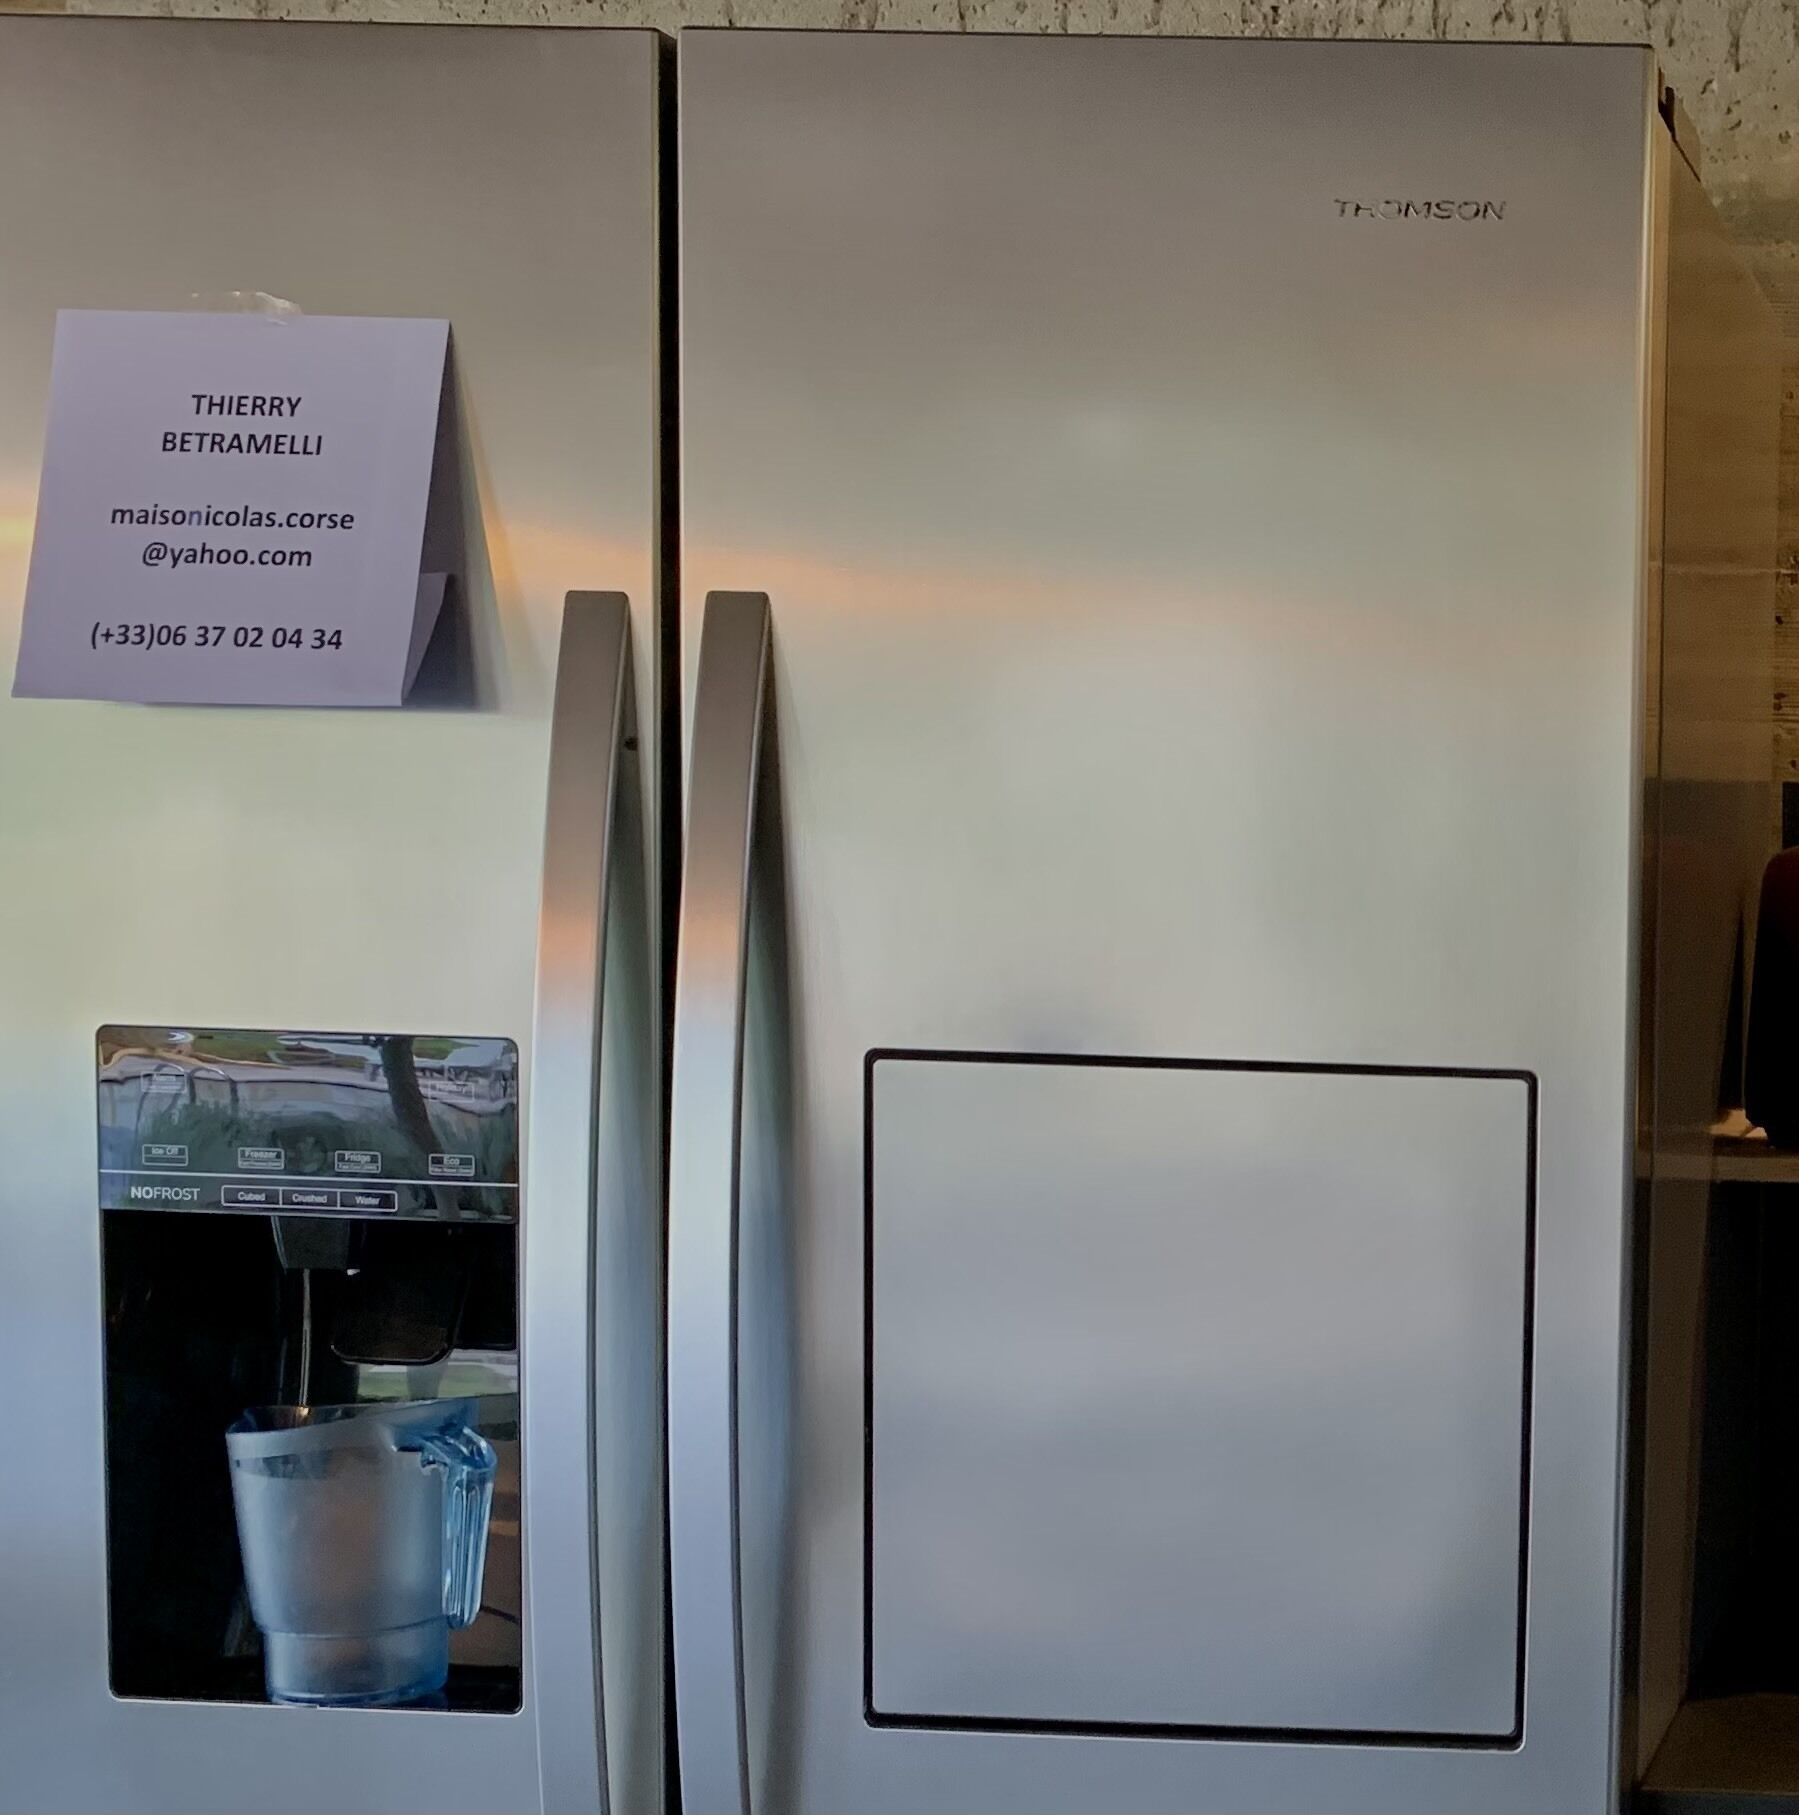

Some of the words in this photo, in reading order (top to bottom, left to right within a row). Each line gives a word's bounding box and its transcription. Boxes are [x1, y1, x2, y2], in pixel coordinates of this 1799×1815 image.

[1334, 198, 1506, 221] THOMSON
[191, 394, 302, 417] THIERRY
[161, 431, 323, 456] BETRAMELLI
[111, 504, 355, 530] maisonicolas.corse
[142, 542, 313, 569] @yahoo.com
[90, 621, 187, 651] (+33)06
[194, 625, 226, 647] 37
[233, 626, 264, 649] 02
[271, 627, 304, 649] 04
[311, 628, 343, 651] 34
[244, 1149, 278, 1159] Freezer
[344, 1153, 372, 1165] Fridge
[443, 1155, 461, 1165] Eco
[130, 1186, 201, 1201] NOFROST
[237, 1191, 266, 1201] Cubed
[292, 1193, 328, 1204] Crushed
[355, 1195, 381, 1206] Water
